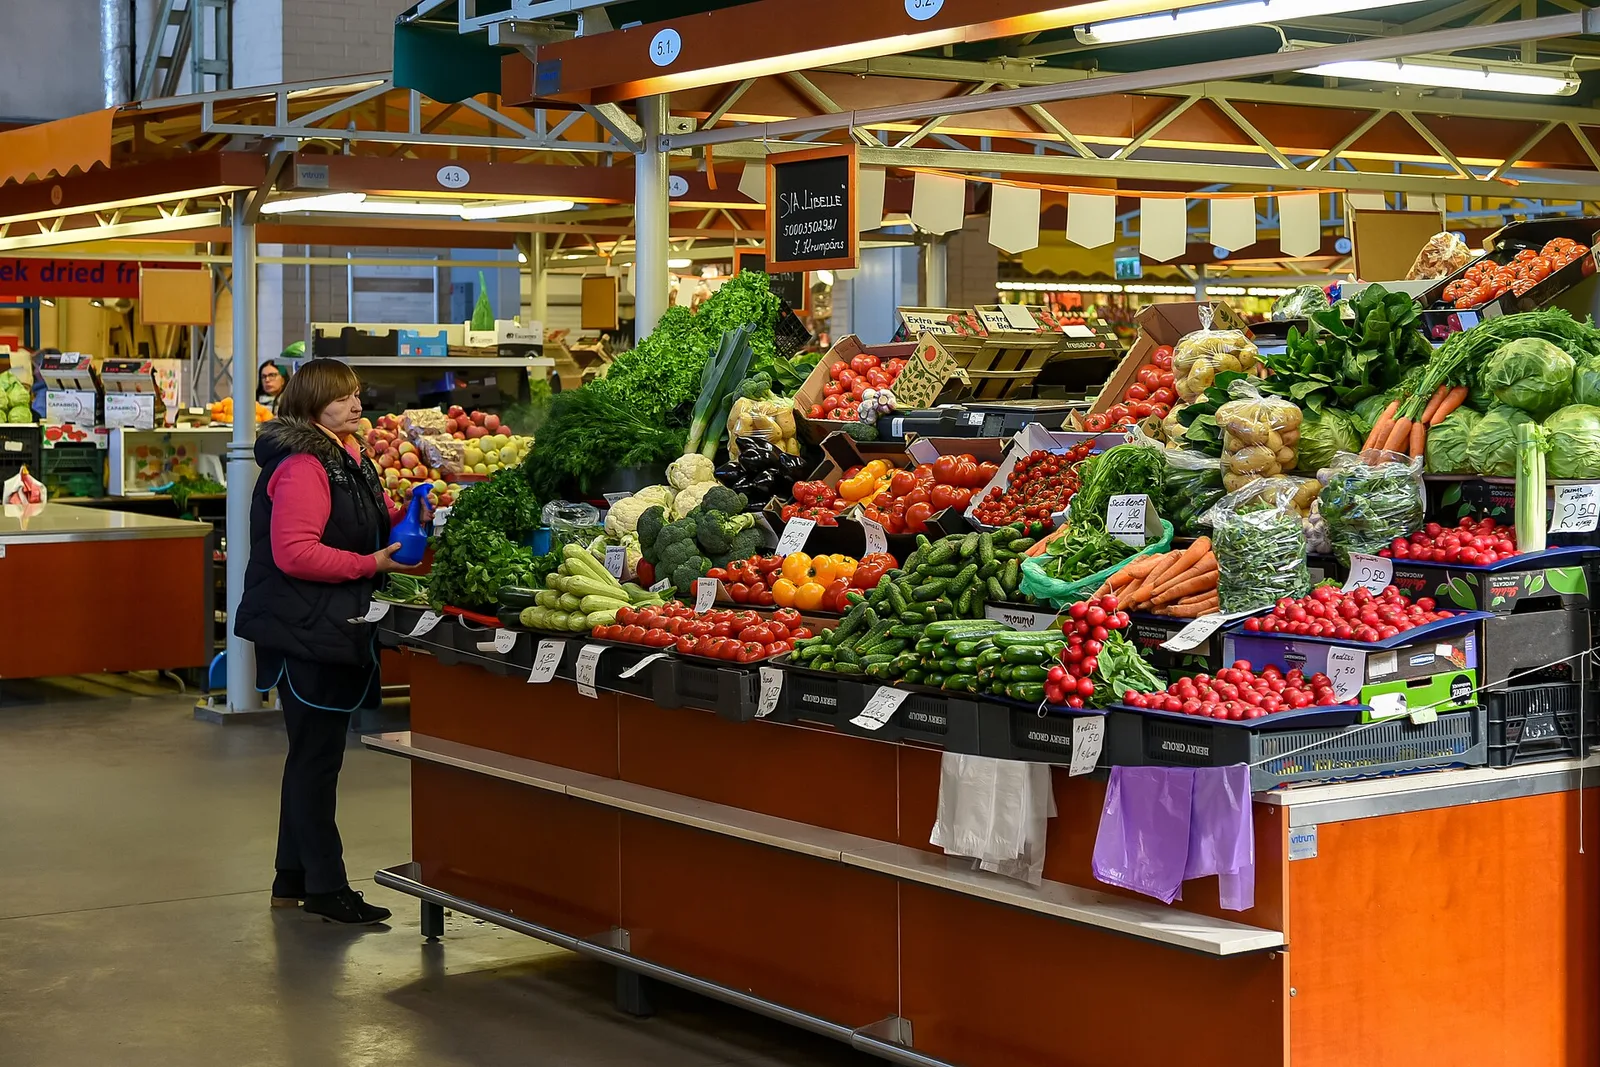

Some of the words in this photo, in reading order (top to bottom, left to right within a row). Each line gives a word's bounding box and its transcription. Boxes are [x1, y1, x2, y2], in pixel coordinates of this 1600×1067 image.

[657, 39, 674, 56] 5.1.
[444, 172, 462, 182] 4.3.
[40, 261, 105, 284] dried
[116, 262, 140, 284] fr
[907, 315, 933, 325] Extra
[1066, 341, 1096, 349] fresalco
[1578, 503, 1597, 516] 50
[1373, 569, 1386, 580] 50
[1344, 666, 1356, 675] 50
[802, 693, 820, 704] GROUP
[820, 696, 837, 707] BERRY
[908, 711, 928, 722] GROUP
[927, 714, 947, 725] BERRY
[1027, 731, 1050, 742] GROUP
[1049, 734, 1070, 746] BERRY
[1088, 733, 1100, 743] 50
[1161, 740, 1186, 753] GROUP
[1185, 744, 1210, 757] BERRY
[1291, 834, 1315, 844] vitrum
